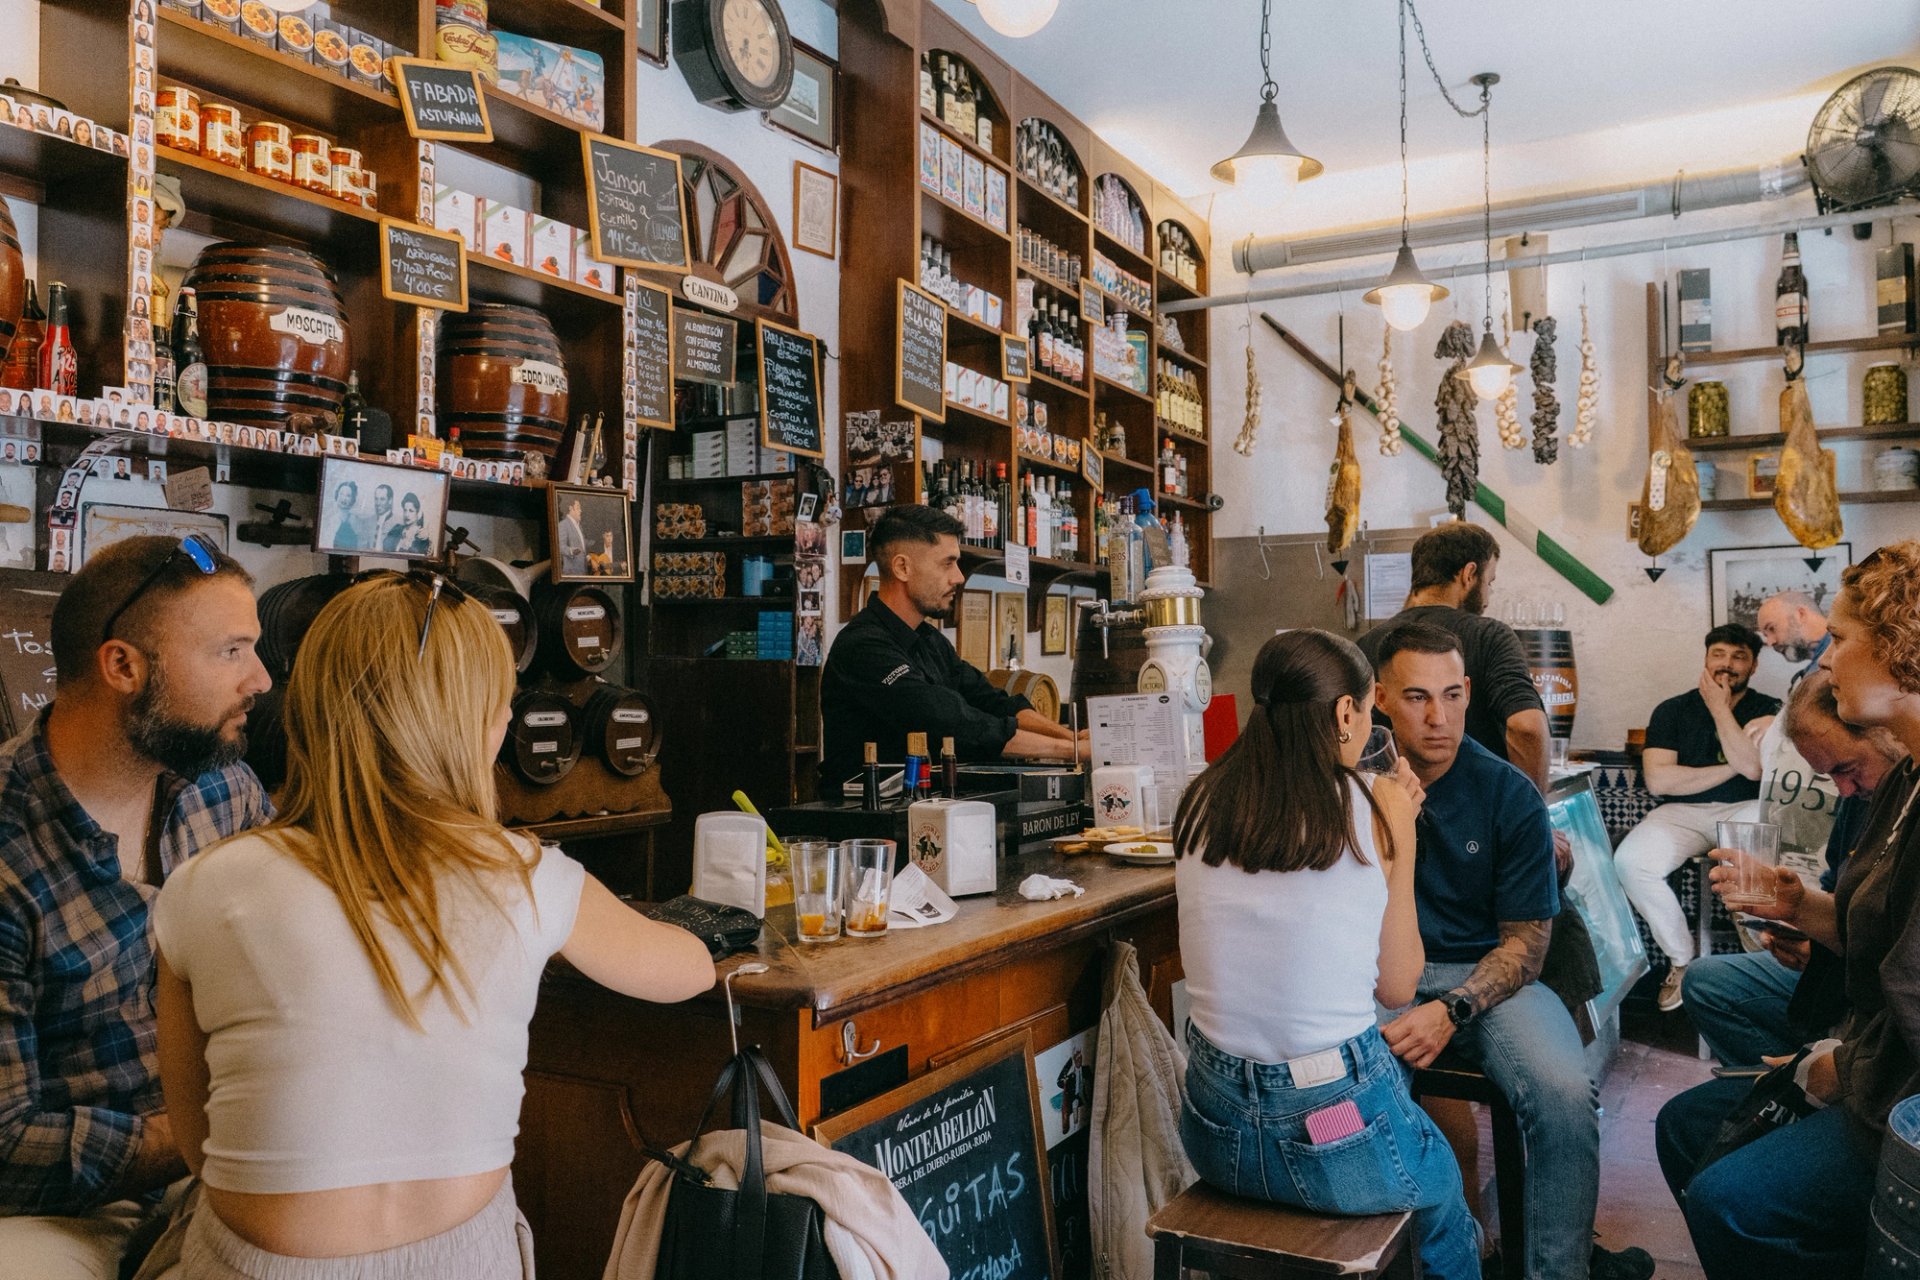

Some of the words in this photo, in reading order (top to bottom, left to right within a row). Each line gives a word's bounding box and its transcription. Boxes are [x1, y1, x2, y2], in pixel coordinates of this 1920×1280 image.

[410, 80, 479, 105] FABADA
[691, 281, 730, 307] CANTINA
[286, 313, 338, 340] MOSCATEL
[904, 307, 914, 321] DE
[914, 312, 923, 328] LA
[685, 334, 698, 347] CON
[697, 337, 722, 353] PIÑONES
[687, 348, 696, 356] EN
[711, 352, 719, 361] DE
[1100, 785, 1128, 797] VICTORIA
[1764, 768, 1838, 817] 195
[1053, 816, 1065, 829] DE
[1065, 812, 1081, 828] LEY
[922, 1107, 932, 1120] de
[933, 1101, 942, 1113] la
[941, 1086, 975, 1120] familia
[913, 1168, 926, 1182] DEL
